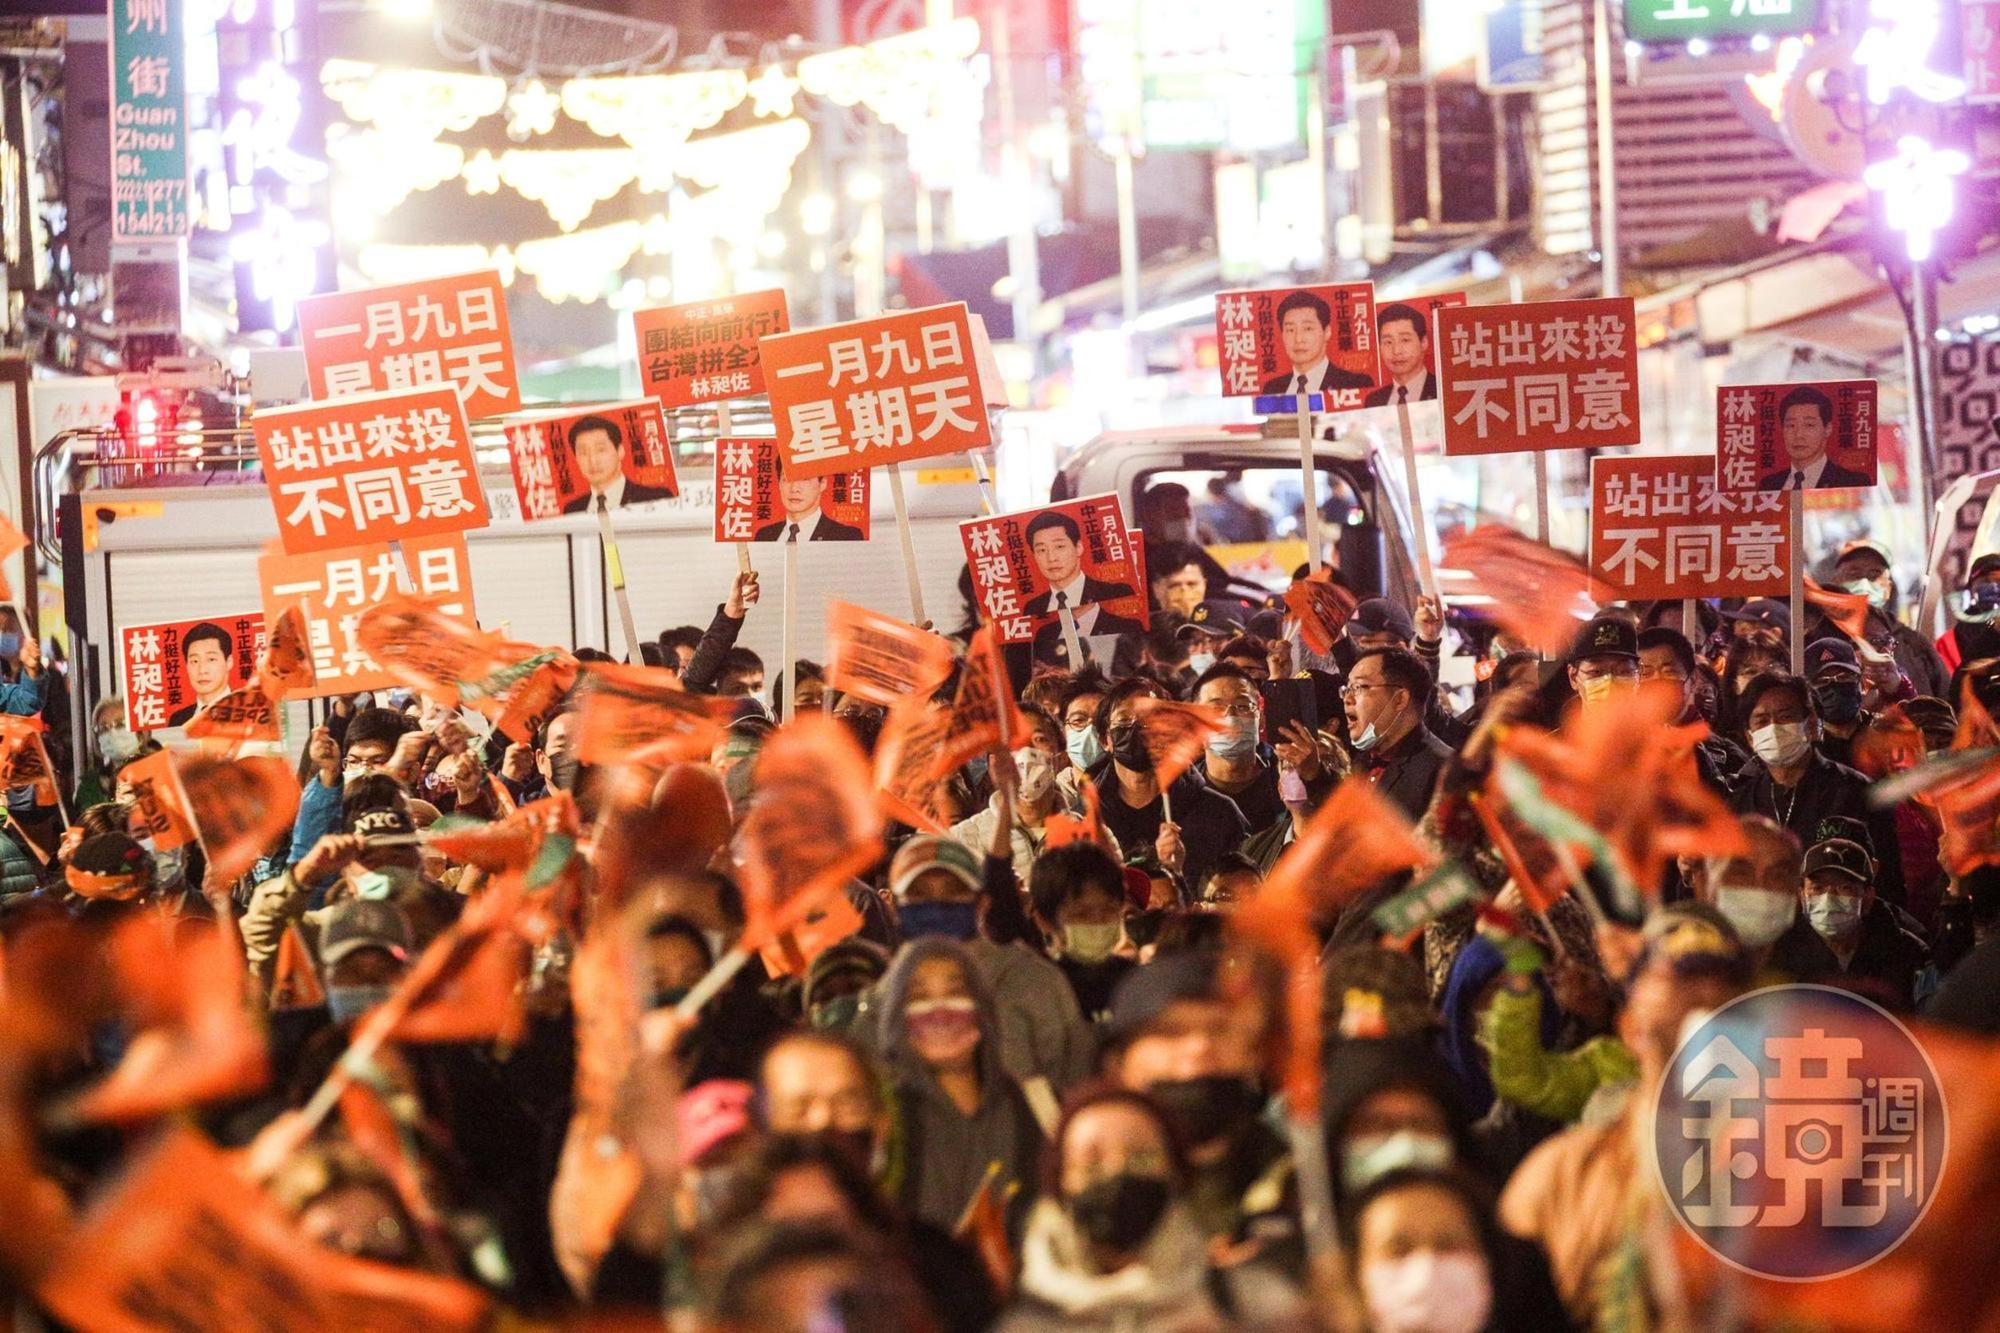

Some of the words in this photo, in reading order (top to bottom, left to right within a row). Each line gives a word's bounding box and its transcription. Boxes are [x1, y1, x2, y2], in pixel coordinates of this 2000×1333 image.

[116, 102, 178, 126] Guan
[116, 127, 176, 151] Zhou
[116, 154, 147, 177] St.
[314, 287, 499, 350] 一月九日
[1222, 296, 1260, 394] 林昶佐
[1257, 295, 1277, 373] 力挺好立委
[1352, 290, 1370, 351] 一月九日
[1451, 314, 1627, 369] 站出來投
[323, 341, 511, 400] 星期天
[690, 372, 751, 399] 林昶佐
[776, 321, 965, 388] 一月九日
[787, 375, 980, 466] 星期天
[1451, 367, 1631, 439] 不同意
[1856, 389, 1871, 449] 一月九日
[268, 407, 458, 472] 站出來投
[640, 410, 665, 466] 一月九日
[1723, 390, 1756, 489] 林昶佐
[280, 458, 476, 537] 不同意
[721, 442, 754, 539] 林昶佐
[757, 442, 773, 520] 力挺好立委
[850, 468, 865, 504] 九日
[1003, 519, 1035, 595] 力挺好立委
[1098, 504, 1125, 562] 一月九日
[1600, 521, 1785, 586] 不同意
[272, 547, 460, 608] 一月九日
[968, 523, 1020, 619] 林昶佐
[129, 629, 166, 727] 林昶佐
[163, 628, 182, 706] 力挺好立委
[236, 619, 253, 680] 中正萬華
[354, 812, 402, 832] NYC
